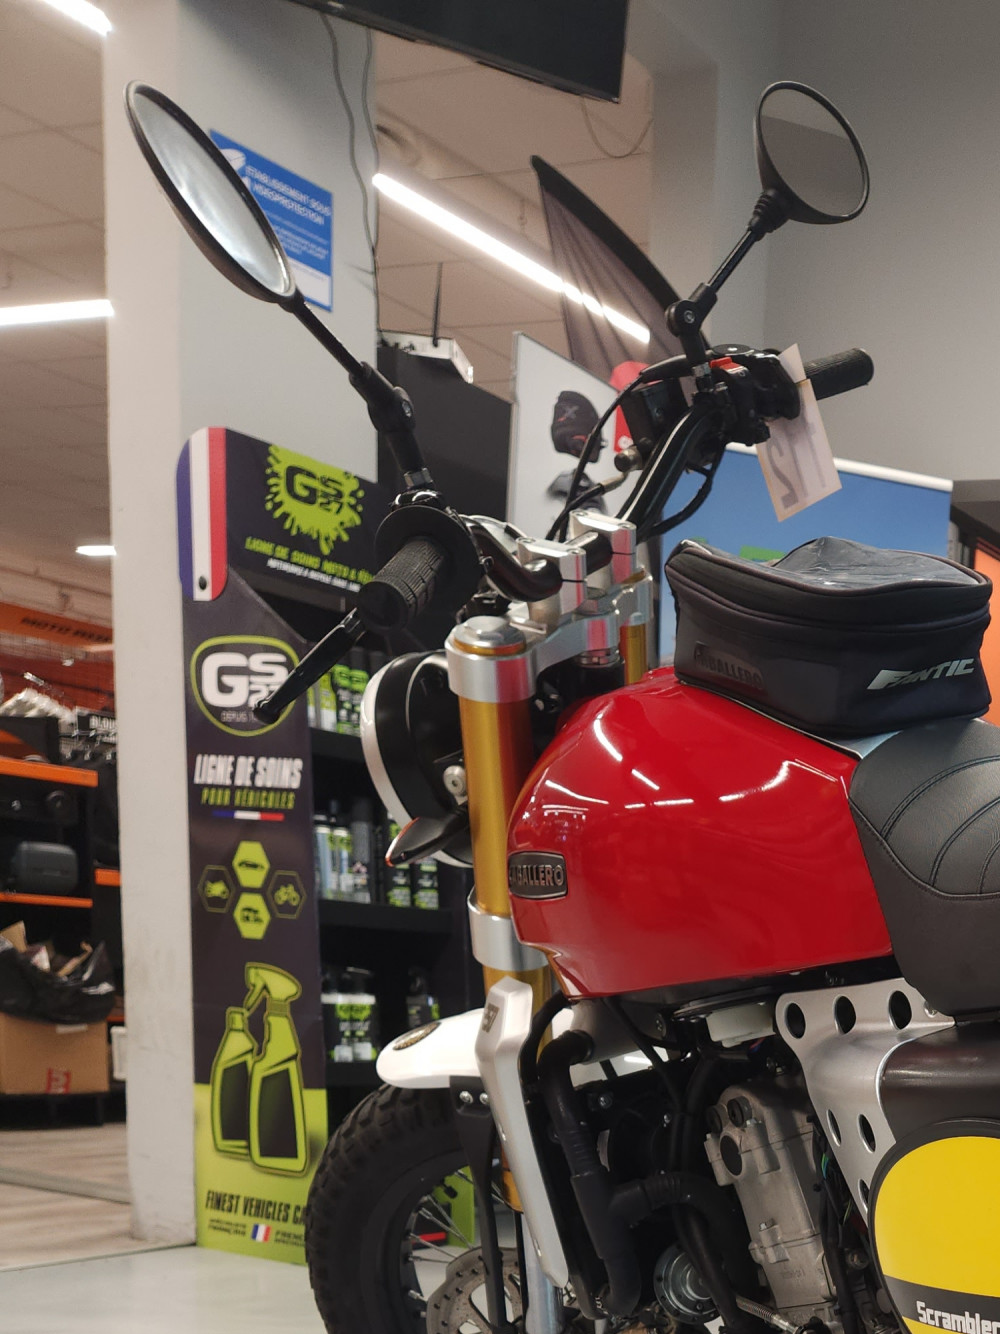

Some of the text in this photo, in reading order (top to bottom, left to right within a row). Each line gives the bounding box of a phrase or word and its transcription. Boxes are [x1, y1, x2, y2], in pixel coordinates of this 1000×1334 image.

[866, 659, 975, 690] FANTIC
[194, 753, 304, 789] LIGNE DE SOINS
[201, 787, 231, 806] POUR
[206, 1189, 241, 1215] FINEST
[242, 1196, 291, 1223] VEHICLES
